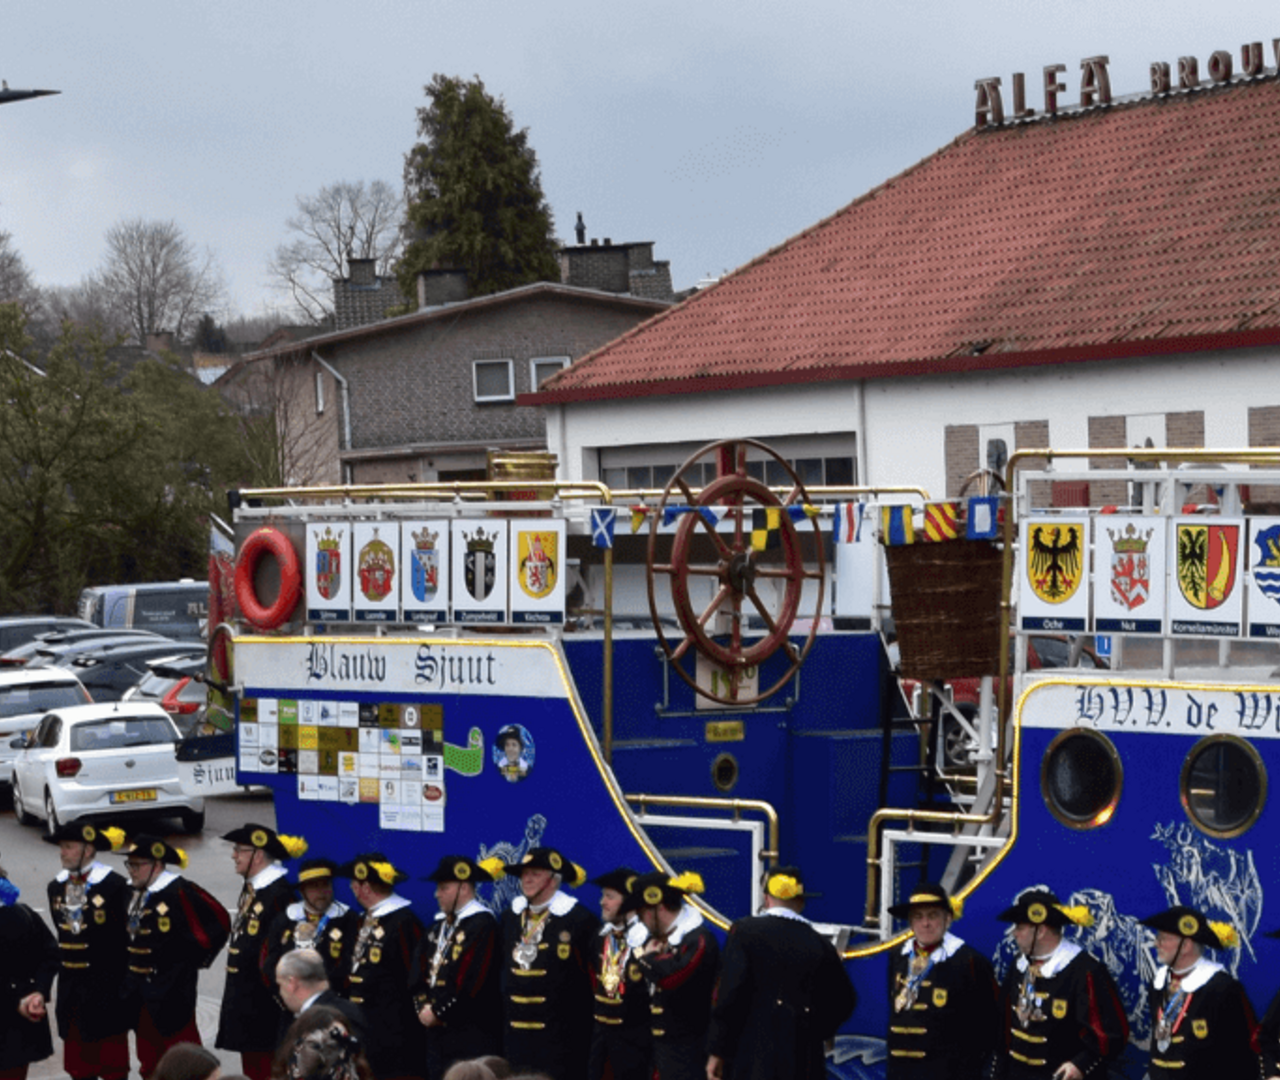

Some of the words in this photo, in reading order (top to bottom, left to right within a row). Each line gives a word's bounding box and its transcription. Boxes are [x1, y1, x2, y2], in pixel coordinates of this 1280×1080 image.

[974, 56, 1112, 126] ALFA
[305, 642, 387, 684] Blauw
[414, 642, 497, 690] Sjuut
[1186, 693, 1218, 730] de
[193, 762, 235, 786] Sjuu
